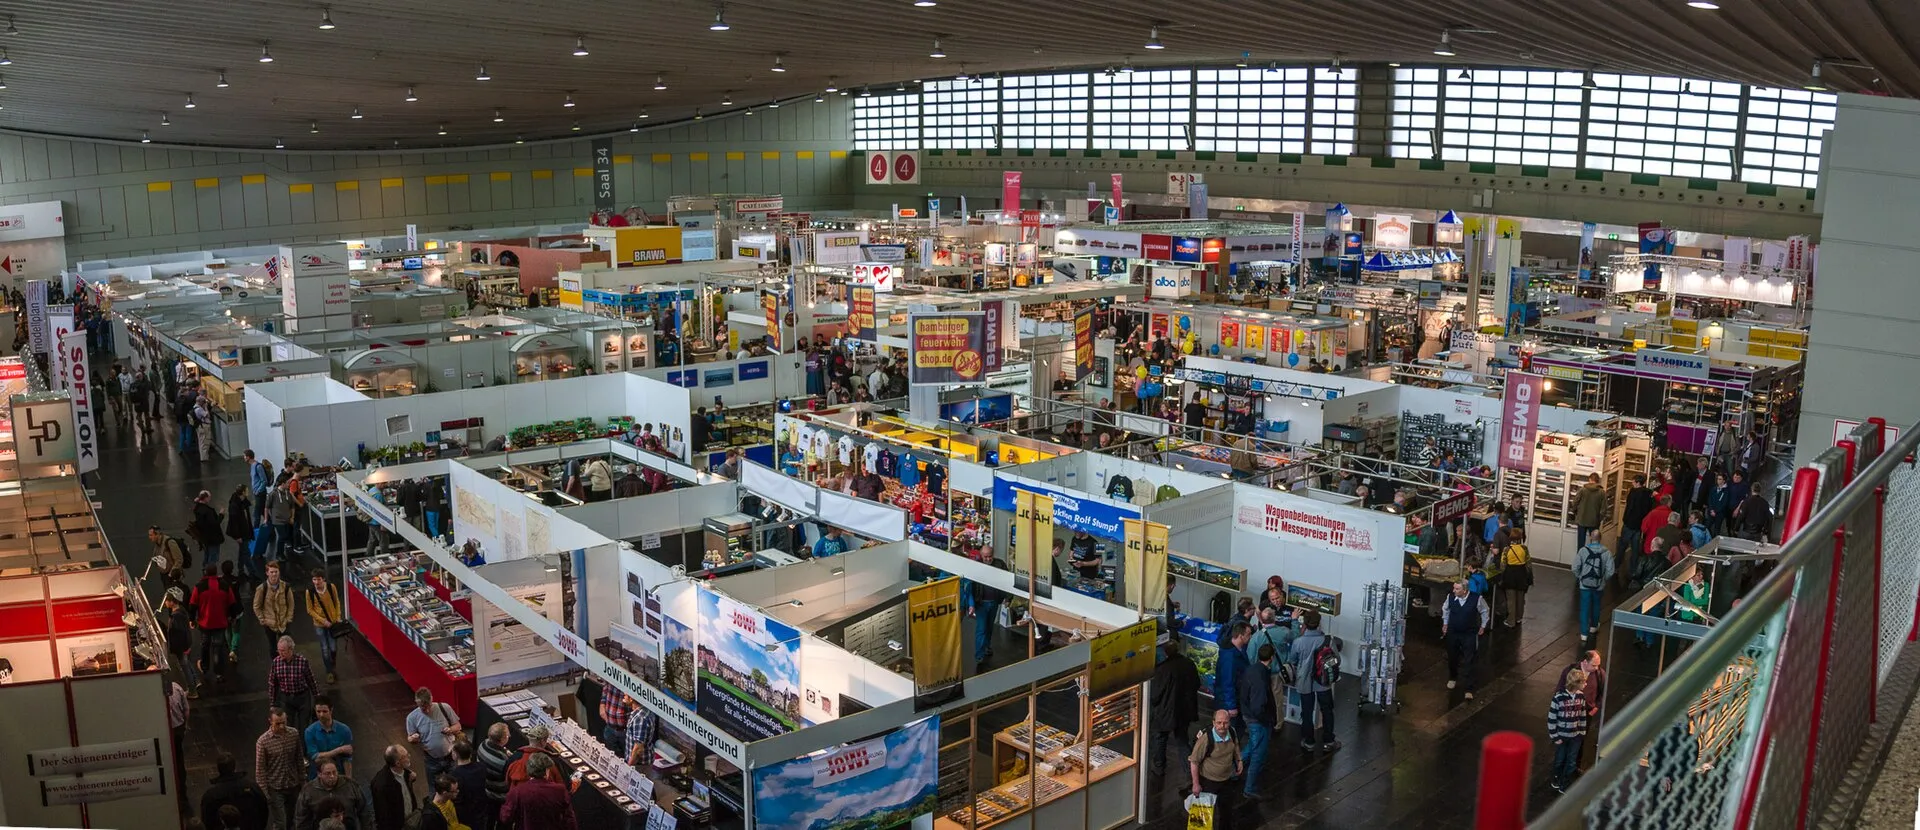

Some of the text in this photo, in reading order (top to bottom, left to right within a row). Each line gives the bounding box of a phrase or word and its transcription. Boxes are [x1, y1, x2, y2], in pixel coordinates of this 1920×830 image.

[597, 147, 611, 198] Saal 34
[874, 159, 883, 176] 4
[900, 159, 910, 176] 4
[634, 249, 665, 262] BRAWA
[1155, 276, 1176, 287] alba
[31, 302, 42, 353] modellplan
[919, 319, 965, 333] hamburger
[919, 335, 966, 348] feuerwehr
[986, 307, 997, 366] BEMO
[1452, 340, 1474, 350] Luft
[919, 352, 952, 366] shop.de
[70, 346, 94, 459] SOFTLOK
[1509, 381, 1532, 463] BEMO
[1265, 504, 1346, 531] Waggonbeleuchtungen
[1438, 496, 1469, 520] BEMO
[1074, 514, 1091, 525] Rolf
[1092, 518, 1119, 532] Stumpf
[1265, 517, 1344, 546] !!! Messepreise !!!
[912, 603, 957, 623] HÄDL
[1131, 624, 1155, 638] HÄDL
[603, 661, 623, 684] JoWi
[623, 676, 738, 760] Modellbahn-Hintergrund
[724, 704, 732, 715] für
[732, 708, 743, 722] alle
[743, 715, 775, 738] Spurweiten
[40, 749, 148, 768] Der Schienenreiniger
[45, 775, 153, 794] www.schienenreiniger.de
